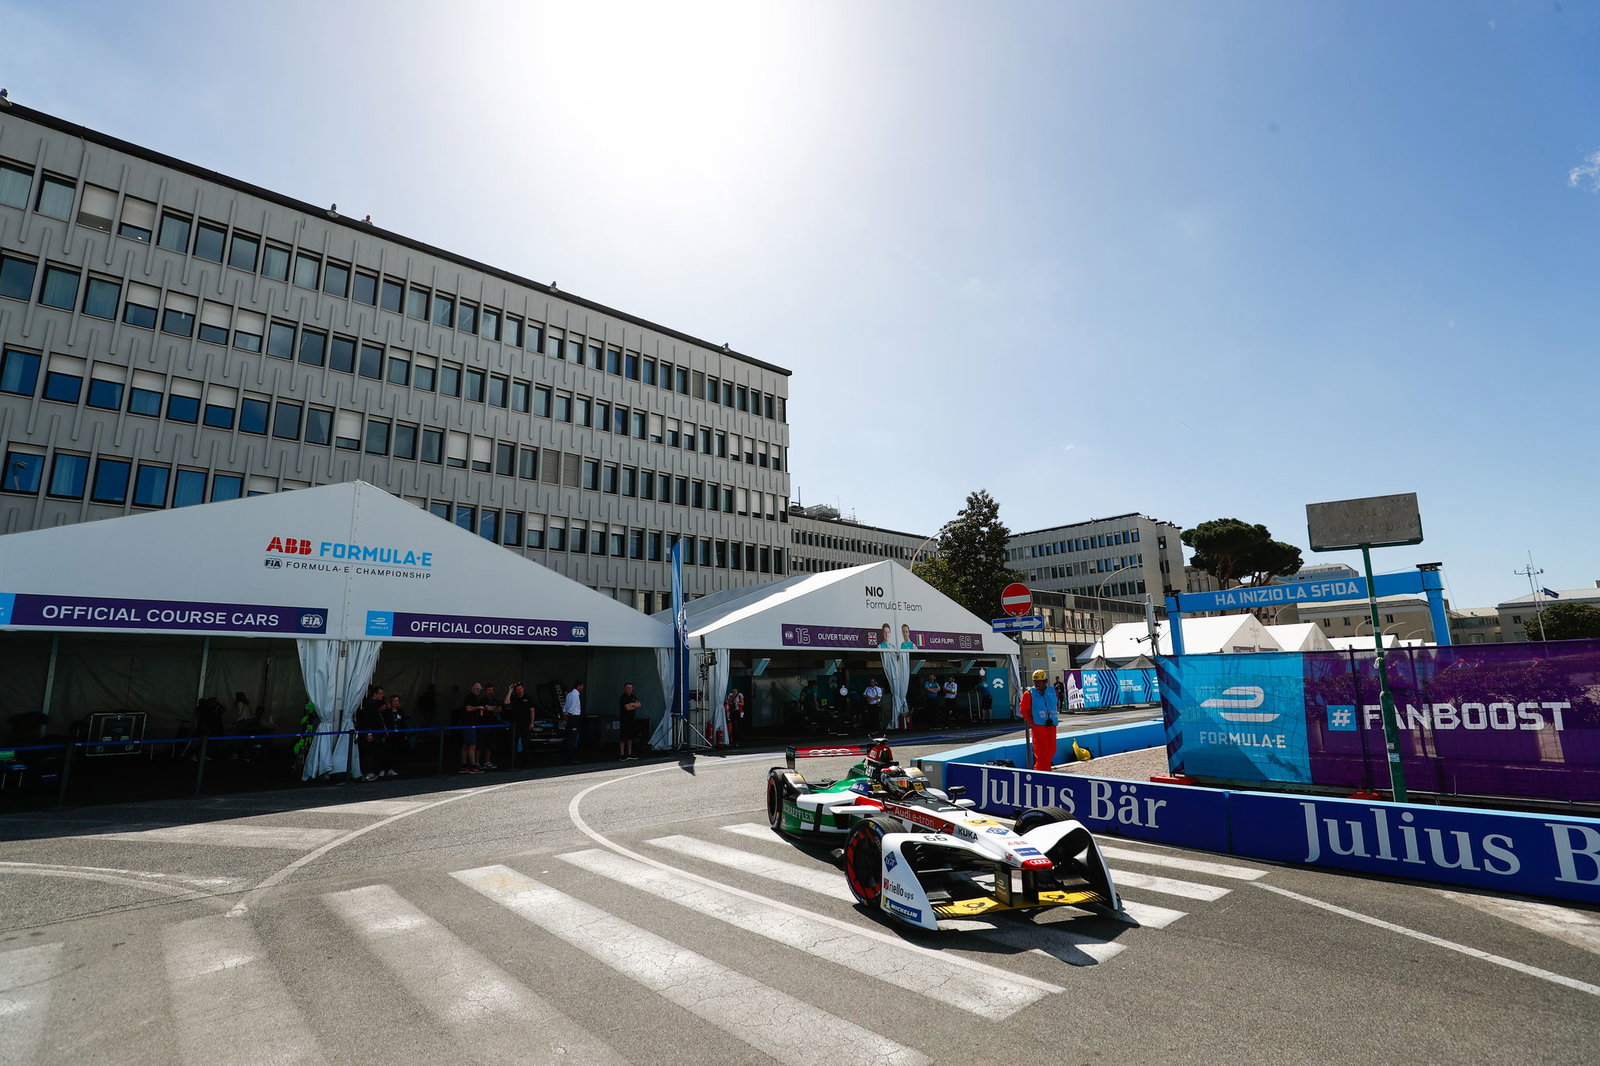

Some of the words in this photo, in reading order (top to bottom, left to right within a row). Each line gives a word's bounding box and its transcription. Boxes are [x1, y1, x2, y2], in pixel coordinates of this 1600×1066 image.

[266, 537, 312, 555] ABB
[319, 542, 432, 567] FORMULA-E
[356, 567, 431, 579] CHAMPIONSHIP
[865, 586, 884, 597] NIO
[1215, 592, 1236, 606] HA
[1239, 588, 1283, 604] INIZIO
[1286, 586, 1307, 600] LA
[1311, 581, 1359, 598] SFIDA
[866, 599, 897, 611] Formula
[898, 601, 902, 611] E
[903, 601, 922, 611] Team
[42, 604, 141, 622] OFFICIAL
[146, 607, 226, 624] COURSE
[232, 612, 279, 626] CARS
[410, 620, 471, 634] OFFICIAL
[474, 623, 525, 636] COURSE
[527, 625, 558, 637] CARS
[796, 627, 810, 645] 16
[817, 633, 836, 641] OLIVER
[837, 634, 859, 642] TURVEY
[1200, 731, 1286, 749] FORMULA-E
[979, 768, 1075, 815] Julius
[1088, 780, 1167, 828] Bär
[894, 807, 911, 821] Audi
[911, 812, 935, 828] e-tron
[923, 833, 948, 842] 66
[957, 826, 979, 841] KUKA
[1300, 802, 1521, 876] Julius
[889, 880, 904, 897] riello
[890, 903, 918, 918] MICHELIN
